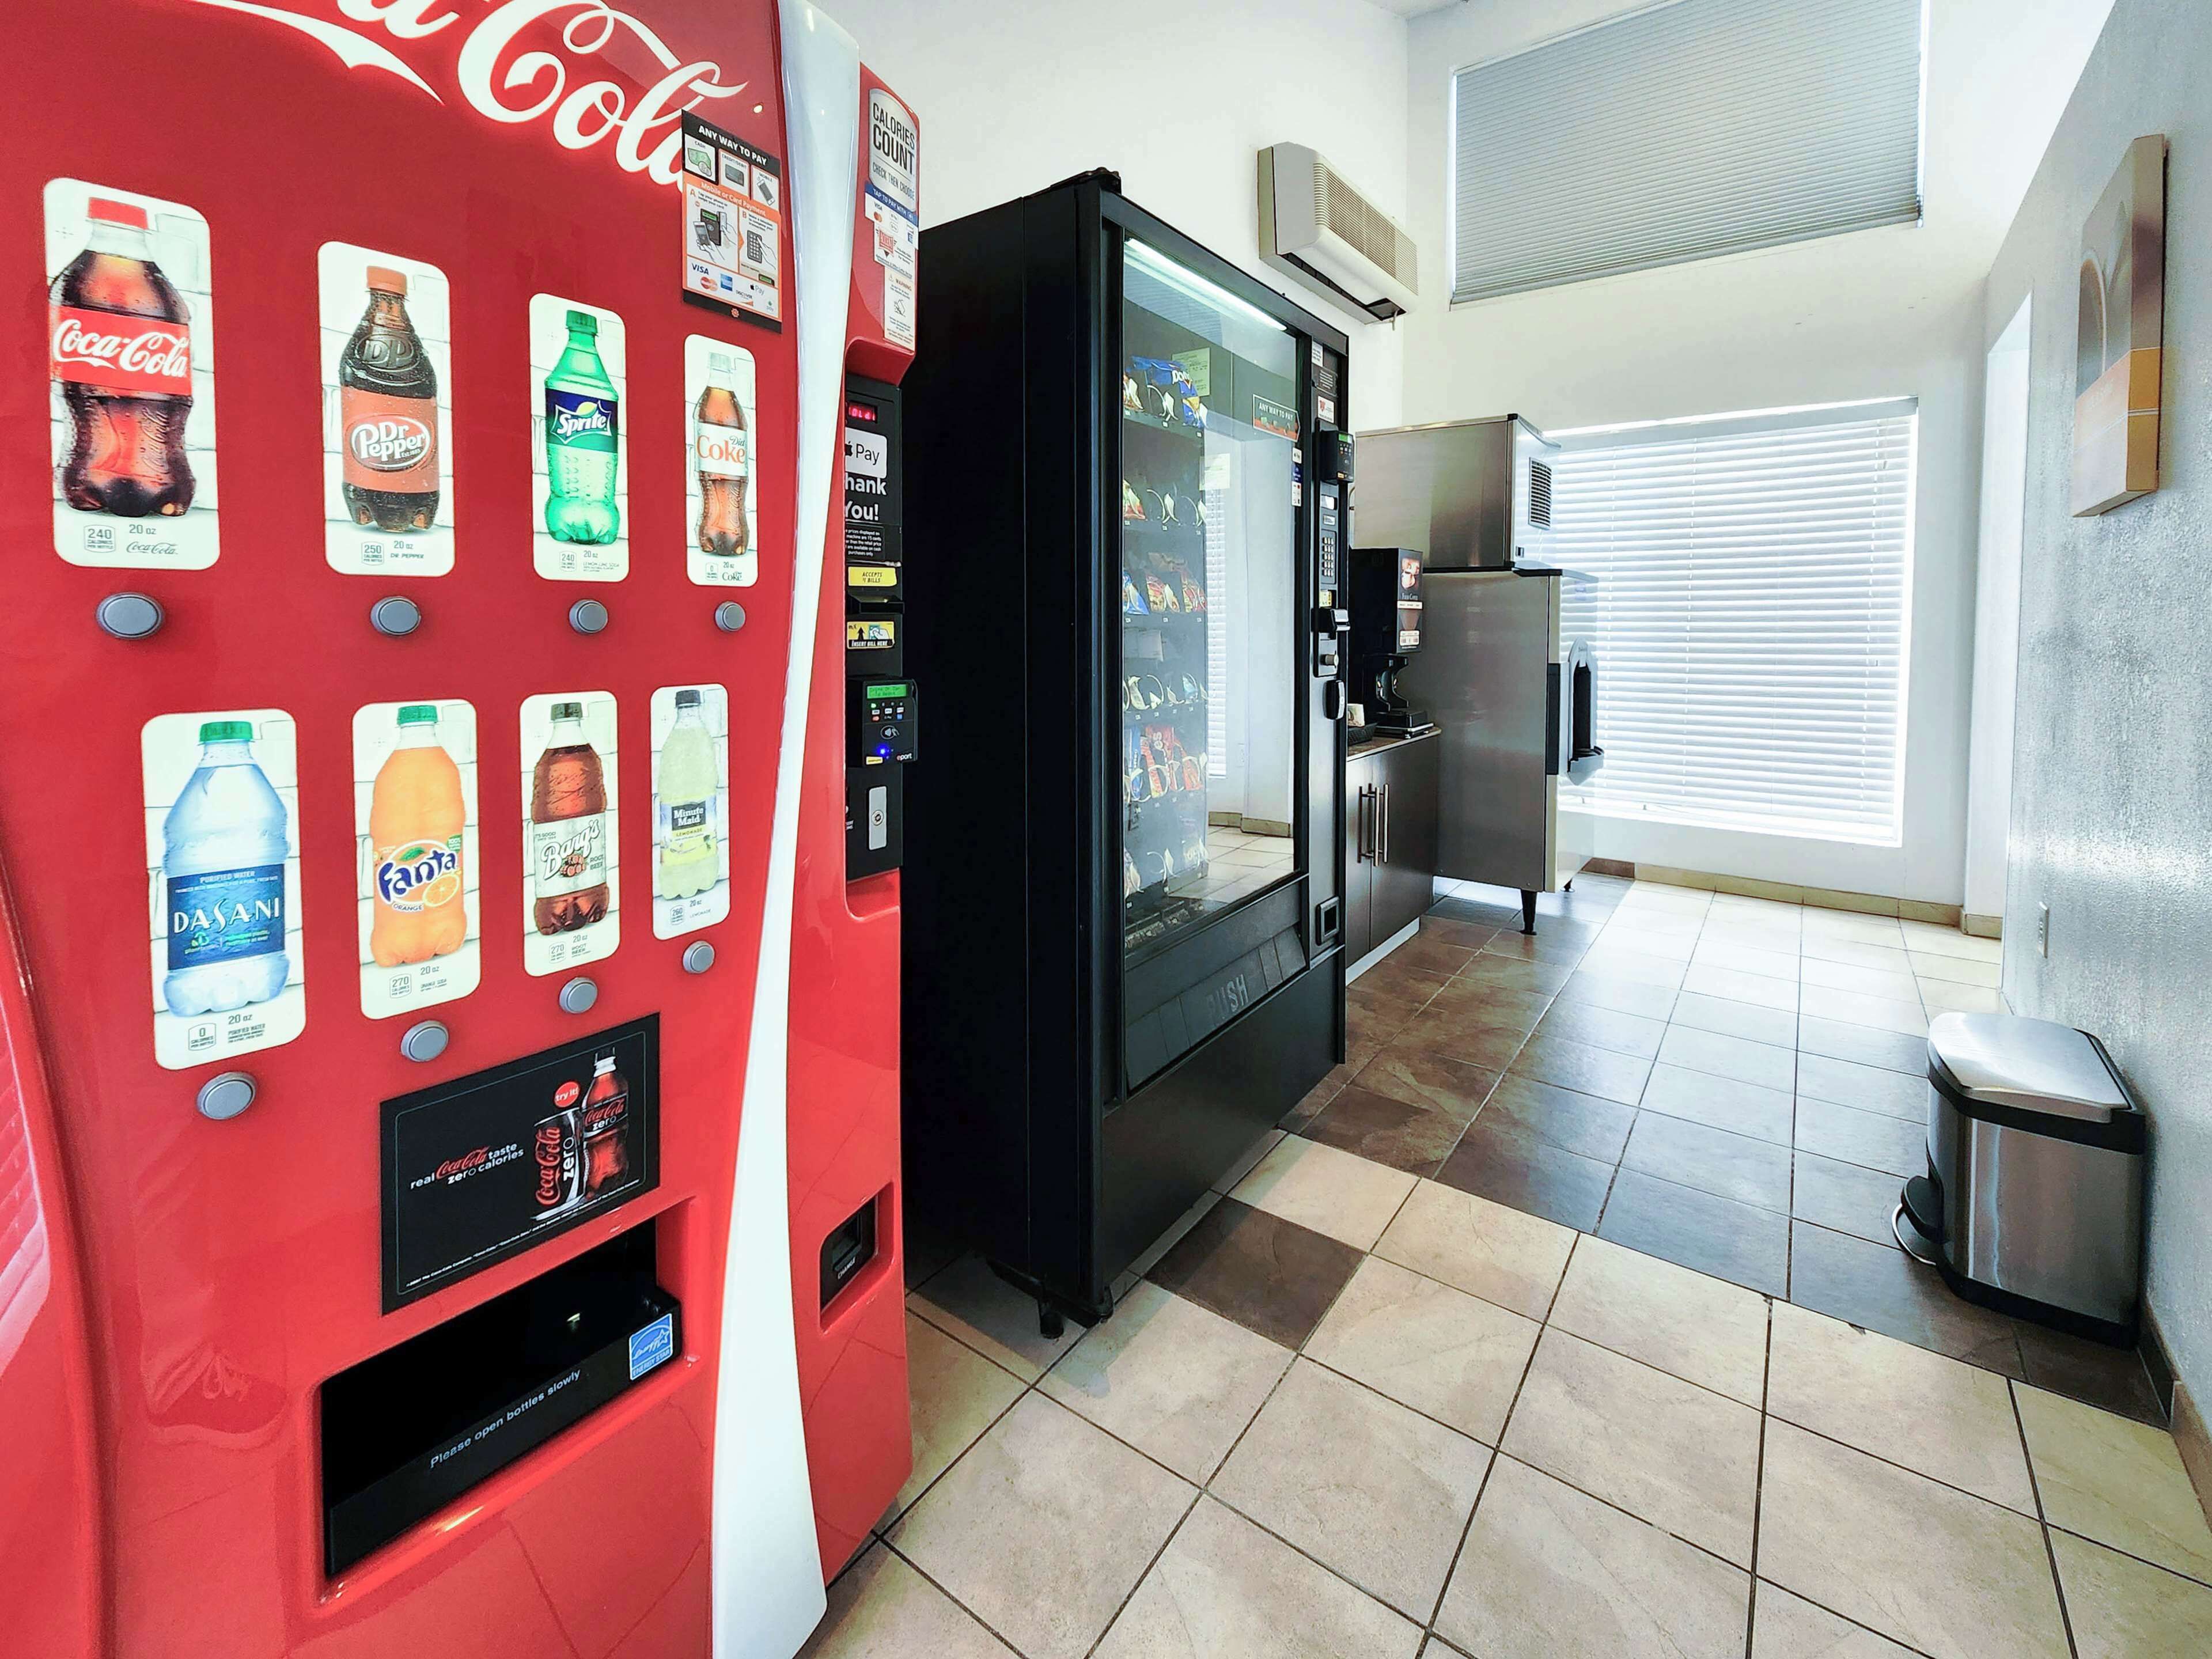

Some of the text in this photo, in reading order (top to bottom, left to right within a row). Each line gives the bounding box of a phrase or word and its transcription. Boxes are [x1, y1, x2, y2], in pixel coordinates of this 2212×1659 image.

[873, 103, 915, 150] CALORIES
[698, 125, 768, 166] ANY WAY TO PAY
[873, 123, 914, 175] COUNT
[873, 162, 887, 180] CHECK
[888, 173, 899, 189] THEN
[690, 189, 696, 197] A
[700, 181, 721, 196] Mobile
[729, 194, 742, 206] Card
[743, 202, 766, 217] Payment
[692, 263, 709, 275] VISA
[755, 286, 764, 296] Pay
[52, 319, 190, 378] Coca-Cola
[363, 340, 415, 369] DP
[1259, 402, 1293, 421] ANY WAY TO PAY
[556, 410, 607, 437] Sprite
[378, 422, 410, 442] Dr
[354, 423, 426, 461] Pepper
[729, 435, 745, 446] Diet
[696, 435, 745, 464] Coke
[855, 444, 880, 465] Pay
[845, 472, 887, 495] hank
[88, 528, 112, 539] 240
[128, 524, 143, 534] 20
[126, 541, 178, 555] Coca-Cola
[364, 544, 382, 554] 250
[393, 540, 404, 549] 20
[562, 554, 575, 562] 240
[722, 571, 742, 581] Coke
[673, 807, 704, 819] Minute
[677, 815, 701, 827] Maid
[676, 828, 703, 837] LEMONADE
[590, 862, 603, 870] BEER
[234, 870, 255, 878] WATER
[378, 850, 457, 903] Fanta
[393, 903, 422, 911] ORANGE
[690, 899, 696, 907] 20
[174, 897, 279, 934] DASANI
[573, 934, 581, 943] 20
[551, 944, 565, 955] 270
[420, 965, 431, 975] 20
[392, 976, 409, 988] 270
[228, 1014, 241, 1025] 20
[199, 1027, 206, 1037] 0
[228, 1027, 249, 1035] PURIFIED
[555, 1086, 579, 1102] try it!
[585, 1098, 625, 1127] Coca-Cola
[592, 1116, 617, 1131] zero
[535, 1126, 561, 1205] Coca-Cola
[563, 1137, 575, 1181] zero
[410, 1143, 517, 1190] real Coca-Cola taste
[448, 1149, 524, 1184] zero calories
[838, 1256, 856, 1280] CHANGE
[430, 1369, 581, 1469] Please open bottles slowly
